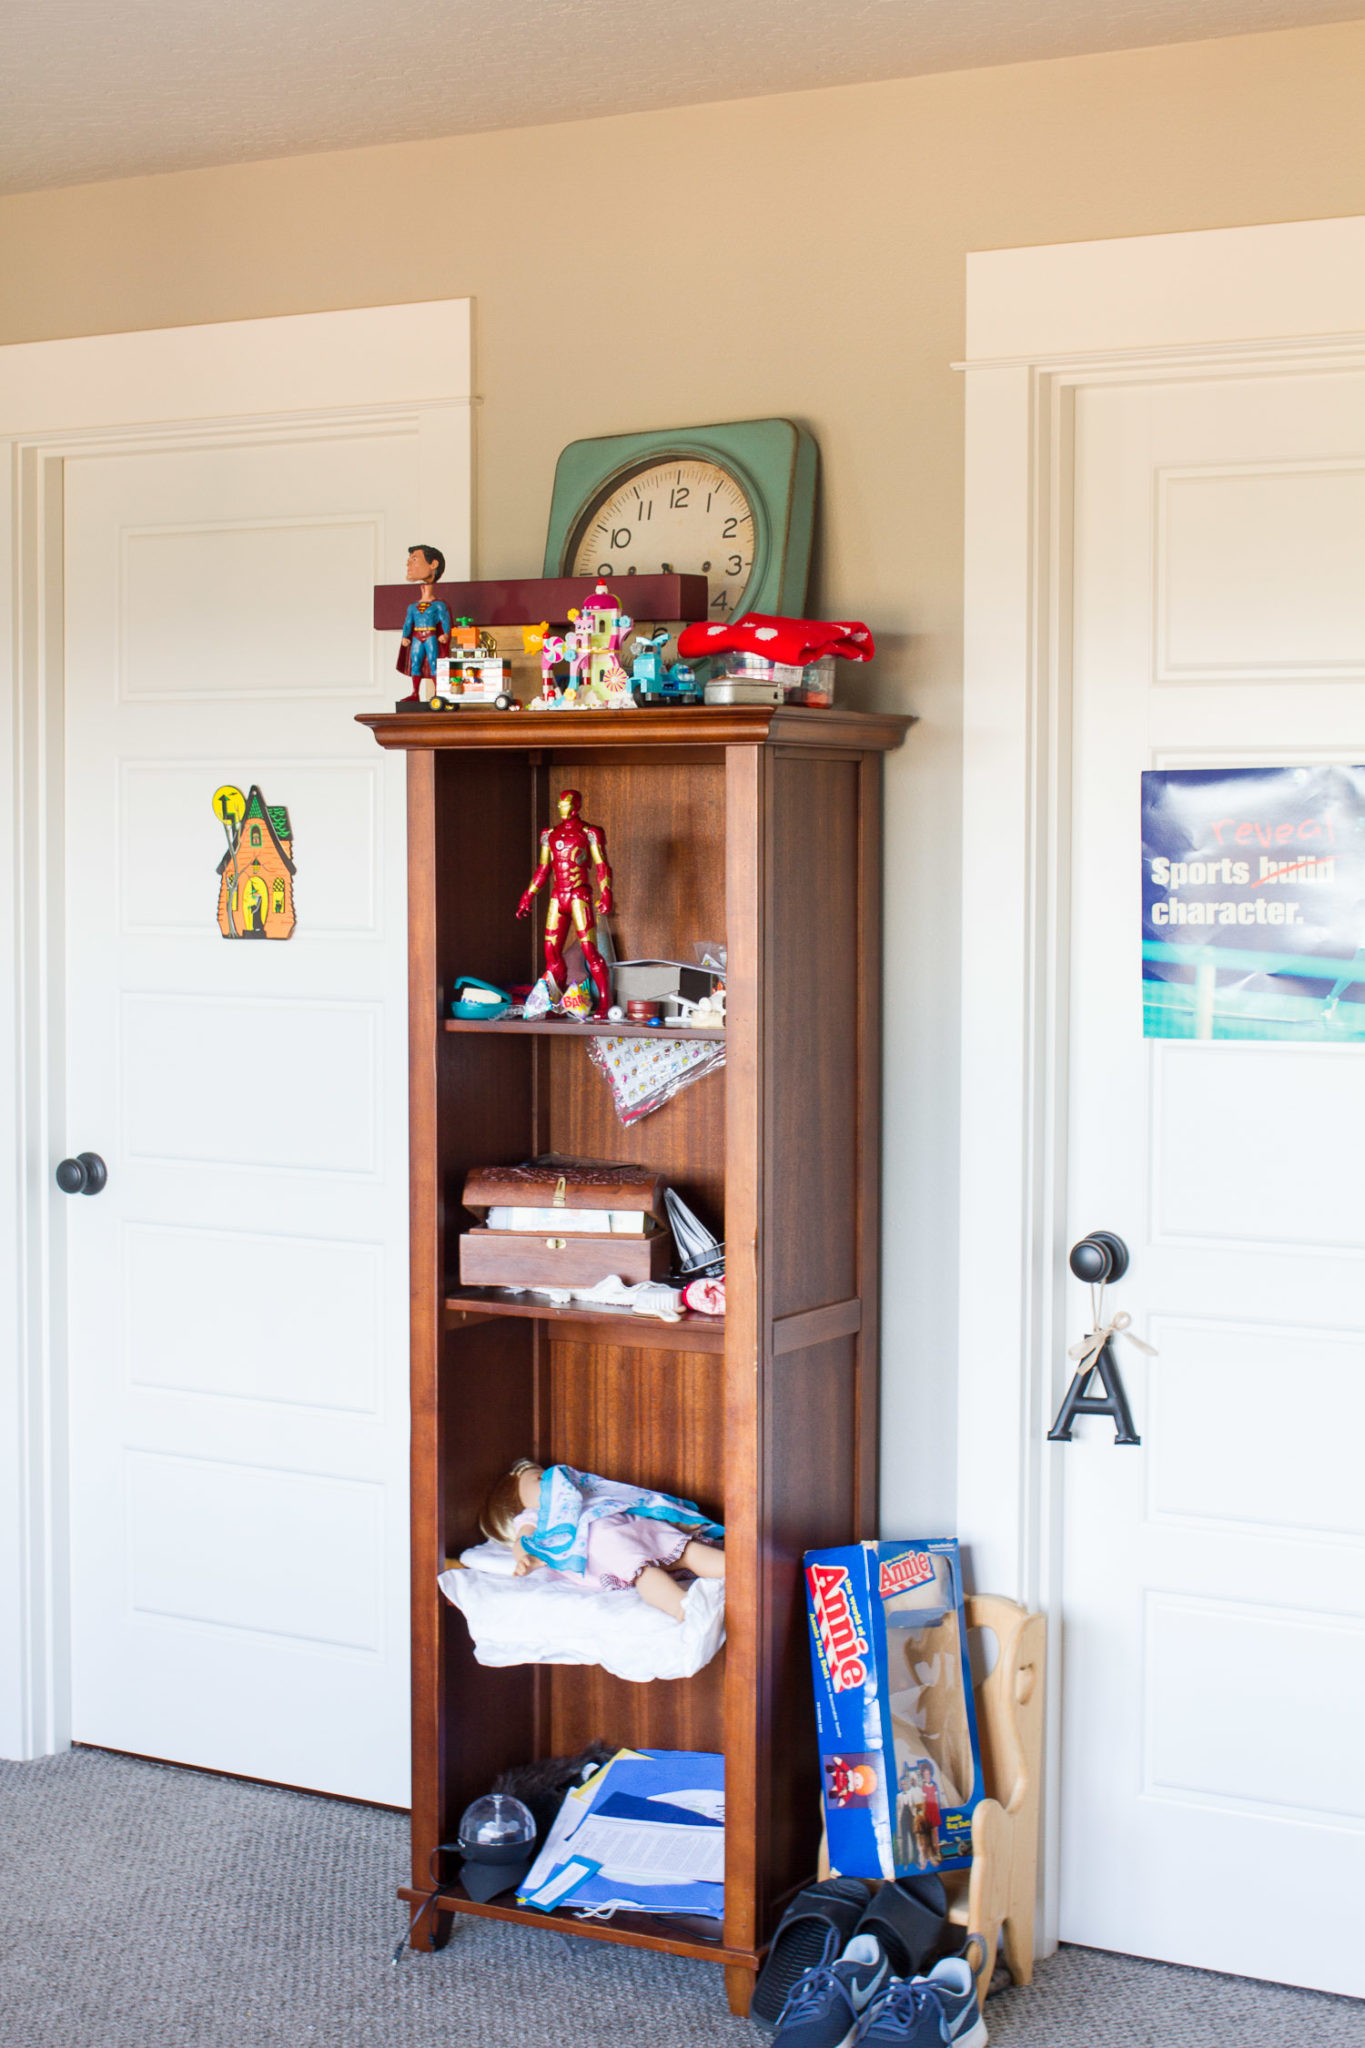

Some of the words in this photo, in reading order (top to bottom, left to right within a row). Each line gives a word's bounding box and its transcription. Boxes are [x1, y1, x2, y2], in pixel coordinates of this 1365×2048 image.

[669, 487, 690, 509] 12
[706, 492, 712, 513] 1
[638, 500, 652, 521] 11
[610, 528, 632, 549] 10
[722, 517, 737, 538] 2
[725, 555, 742, 576] 3
[710, 590, 728, 610] 4
[1210, 812, 1336, 848] reveal
[1151, 857, 1250, 890] Sports
[1259, 856, 1335, 884] build
[1151, 897, 1305, 925] character.
[1047, 1334, 1141, 1446] A
[879, 1550, 931, 1592] Annie
[811, 1563, 869, 1691] Annie
